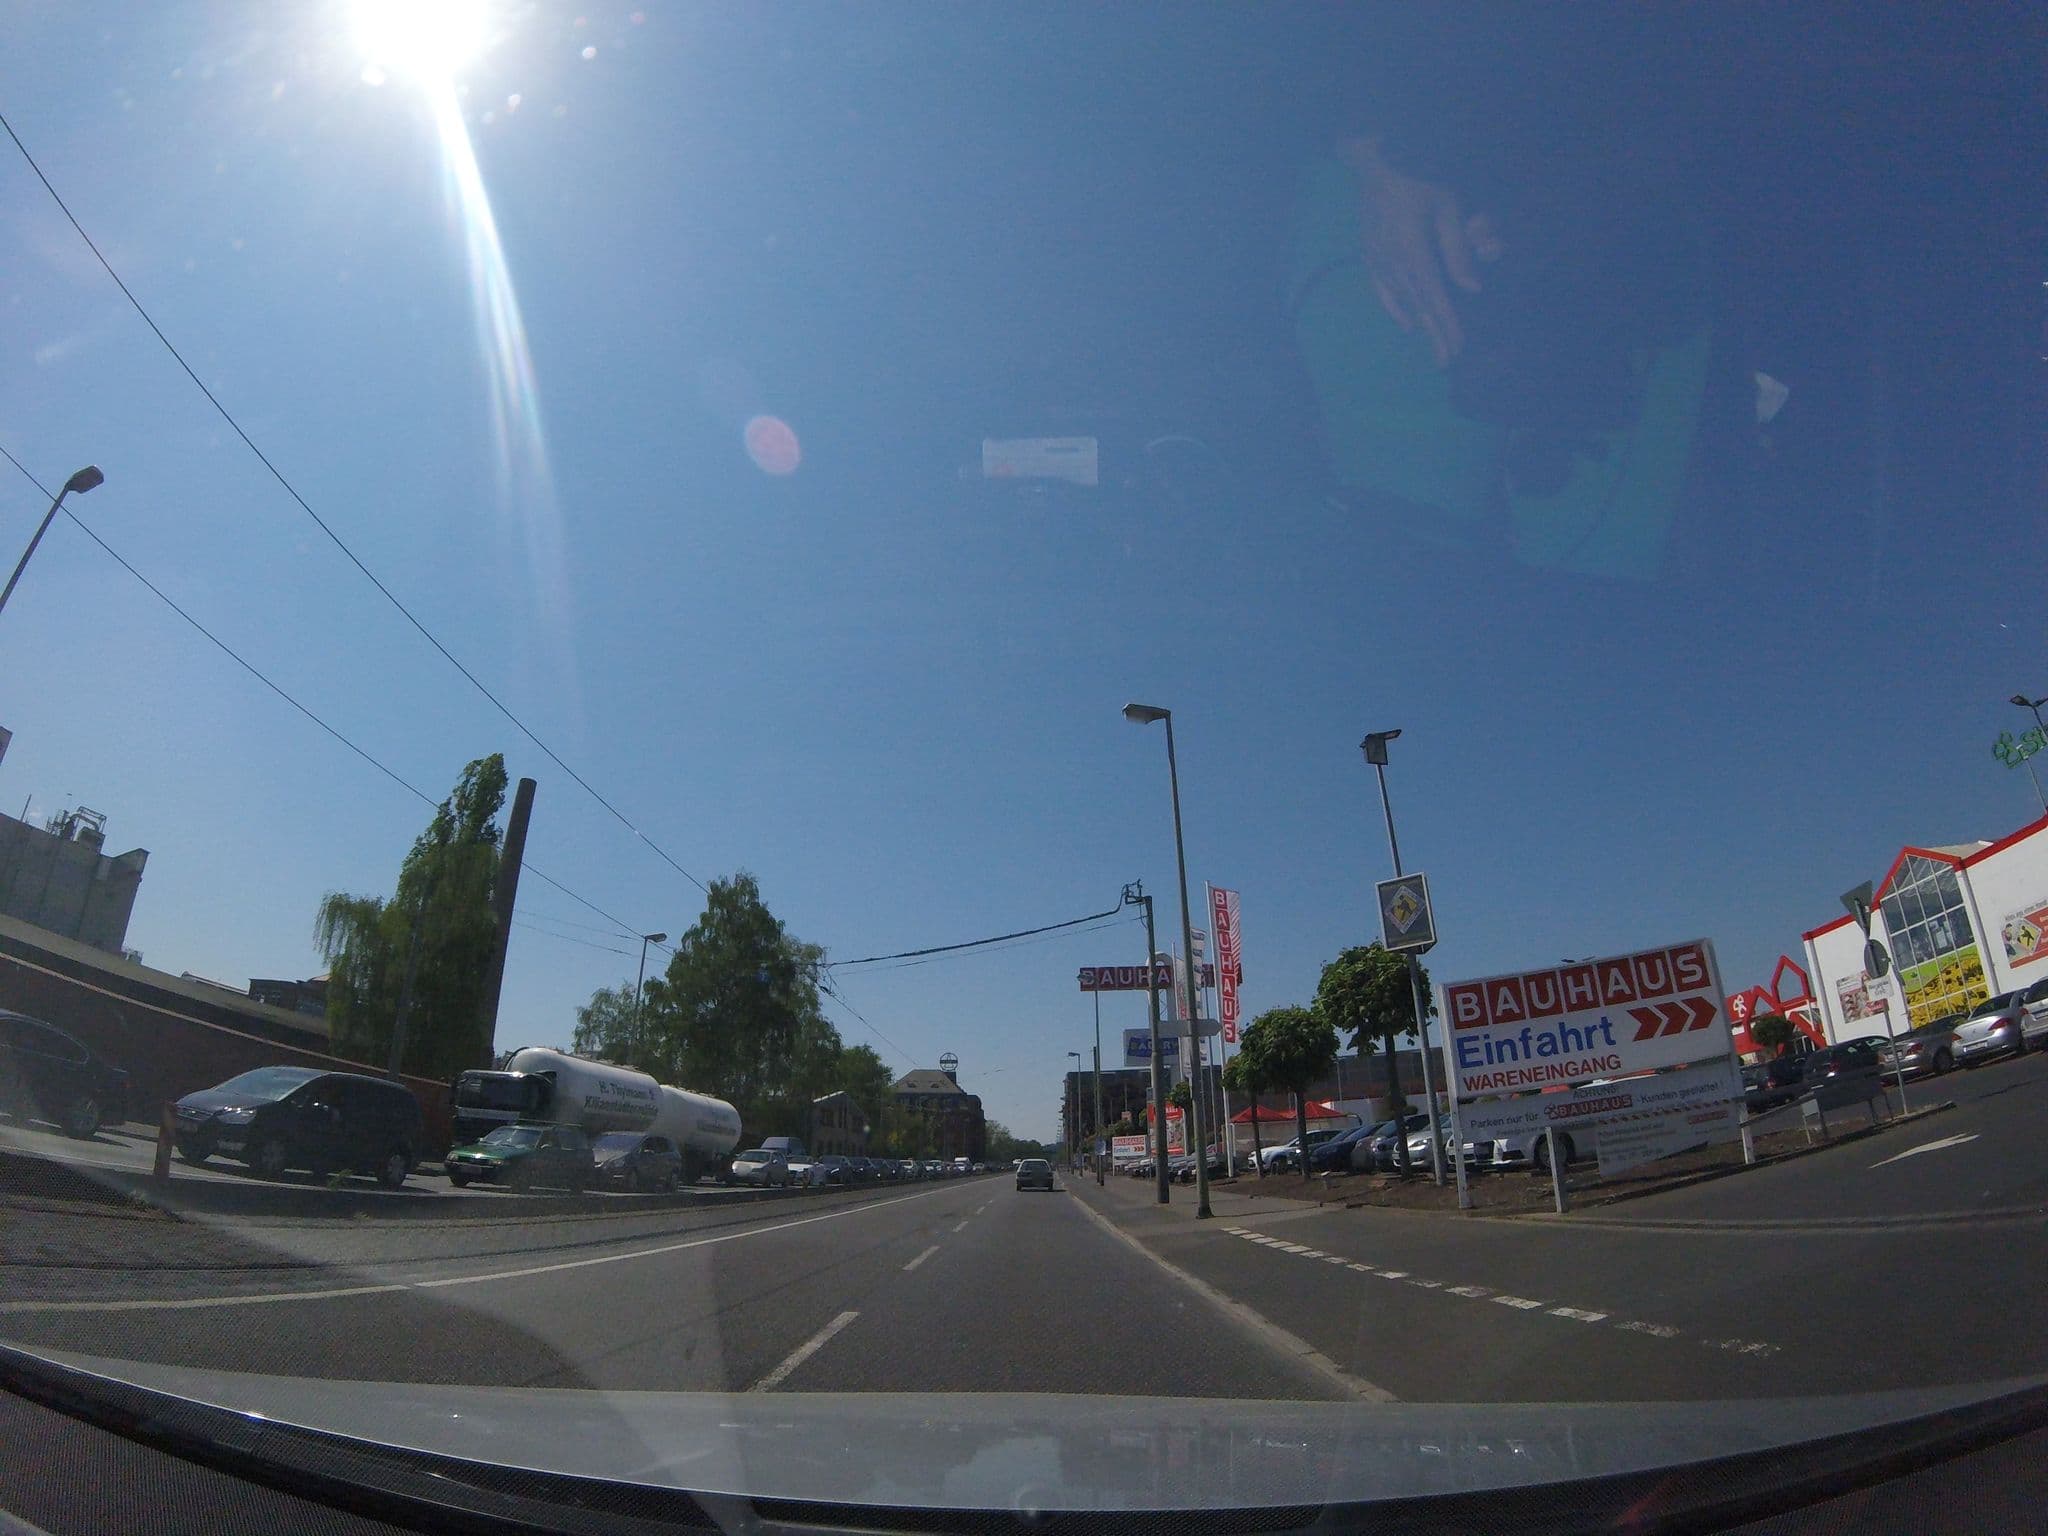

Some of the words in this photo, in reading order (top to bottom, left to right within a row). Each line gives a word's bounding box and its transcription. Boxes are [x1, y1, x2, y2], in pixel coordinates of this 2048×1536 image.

[1214, 891, 1233, 1039] BAUHAUS
[1455, 953, 1703, 1022] BAUHAUS
[1456, 1016, 1616, 1068] Einfahrt
[1463, 1054, 1622, 1092] WARENEINGANG
[1470, 1116, 1504, 1129] Parken
[1506, 1116, 1524, 1126] nur
[1558, 1095, 1632, 1117] BAUHAUS
